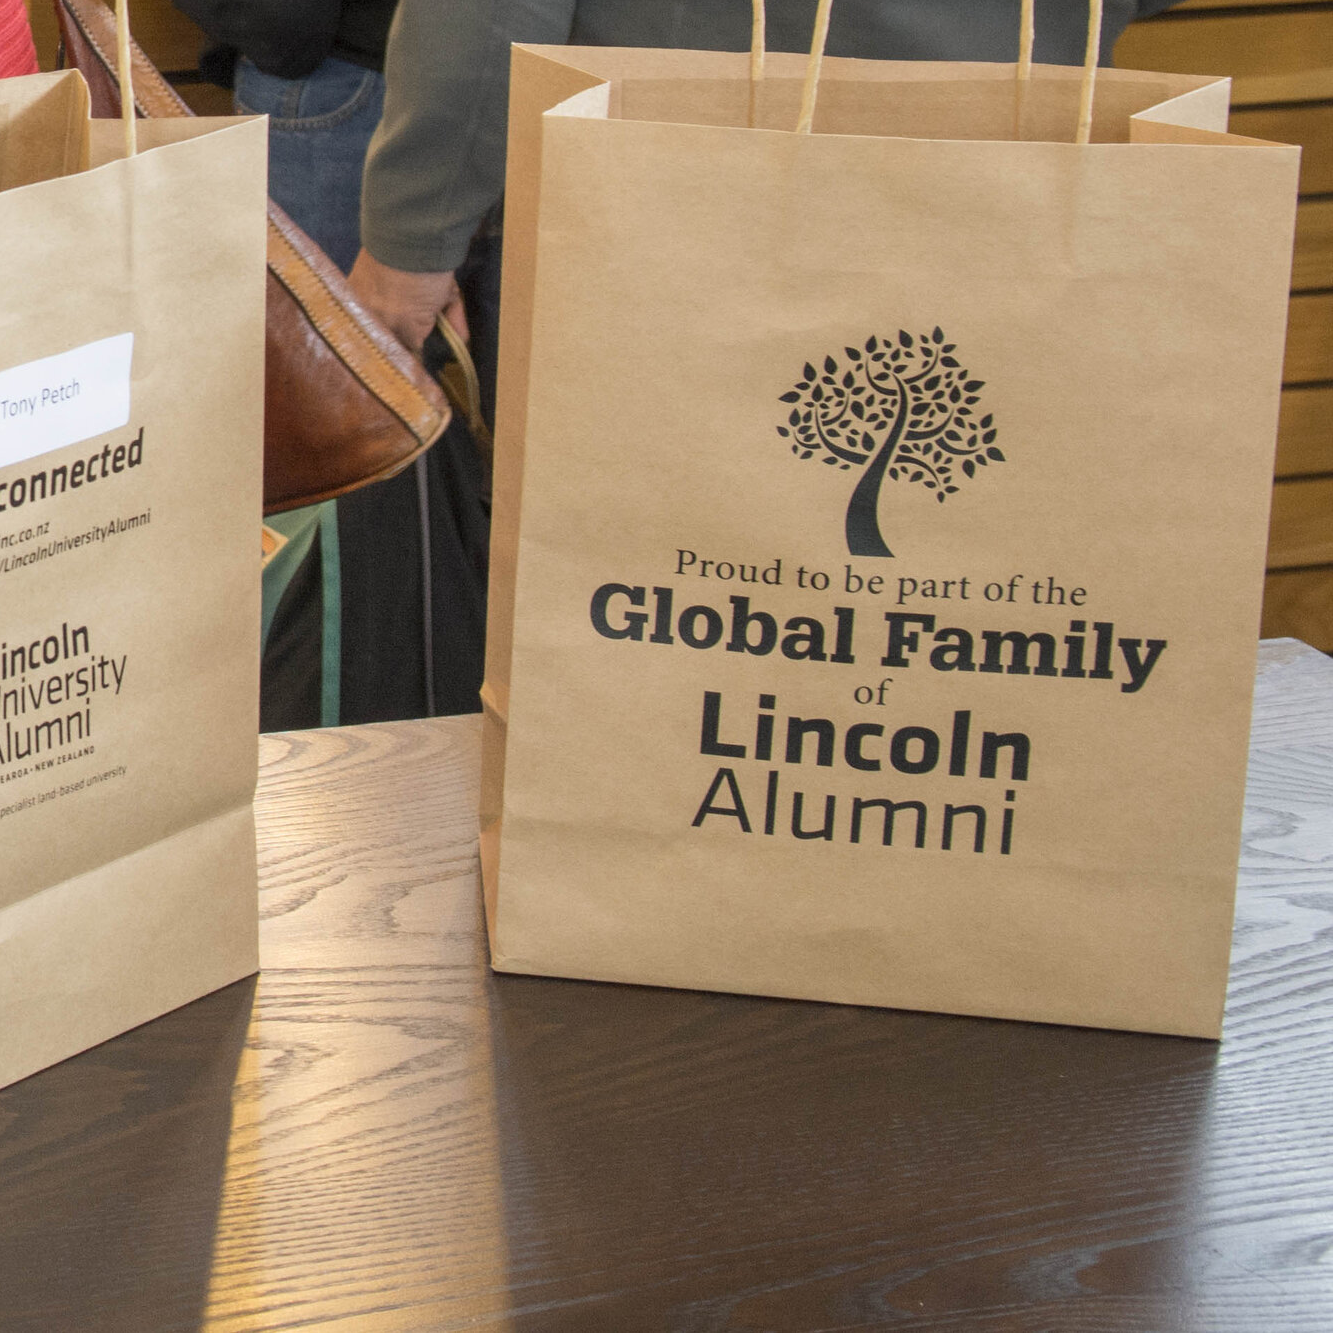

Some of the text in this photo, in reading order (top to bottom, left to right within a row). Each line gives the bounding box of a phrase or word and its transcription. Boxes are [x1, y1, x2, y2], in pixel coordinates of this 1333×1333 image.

[0, 378, 81, 420] Tony Petch
[673, 548, 1088, 607] Proud to be part of the
[589, 581, 1168, 694] Global Family
[853, 677, 894, 706] of
[34, 759, 55, 772] NEW
[56, 745, 95, 766] ZEALAND
[699, 690, 1032, 782] Lincoln
[37, 779, 85, 804] land-based
[86, 765, 128, 789] university
[690, 766, 1016, 857] Alumni
